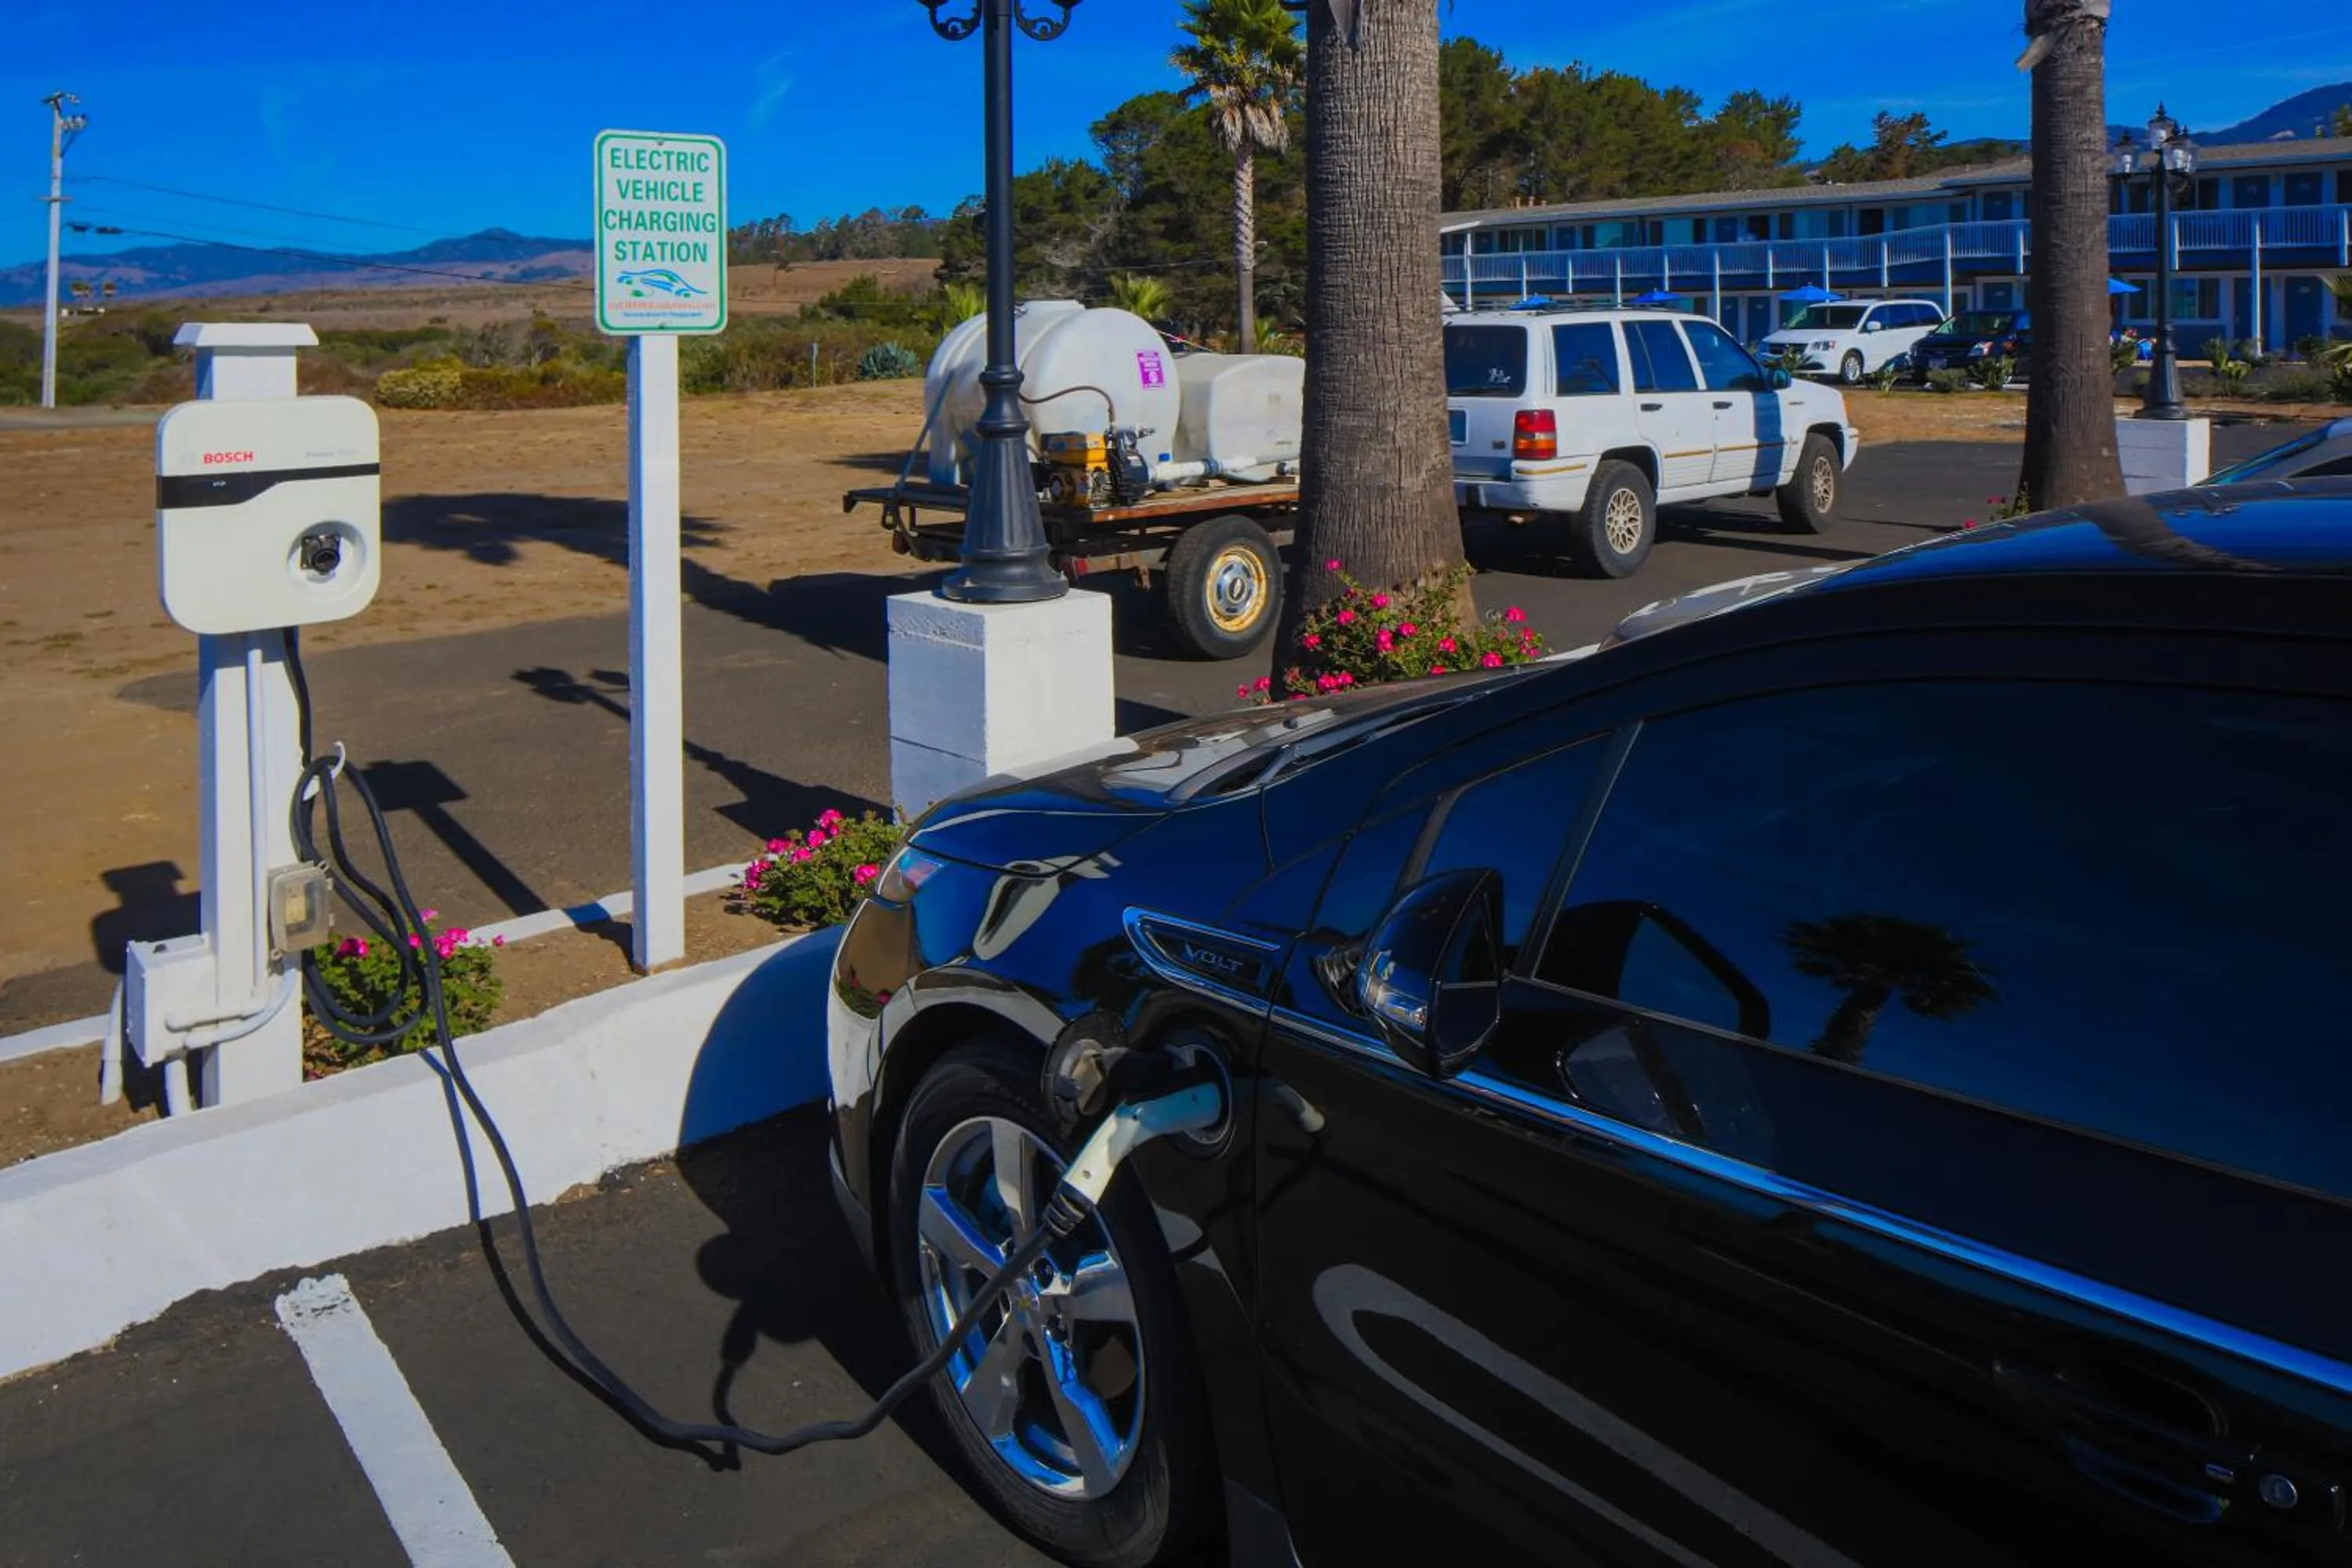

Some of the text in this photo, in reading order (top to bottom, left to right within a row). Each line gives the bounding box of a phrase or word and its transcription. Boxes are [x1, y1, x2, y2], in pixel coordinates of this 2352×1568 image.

[610, 148, 710, 172] ELECTRIC
[616, 179, 703, 201] VEHICLE
[603, 209, 716, 232] CHARGING
[615, 241, 709, 262] STATION
[203, 451, 254, 463] BOSCH
[1184, 942, 1243, 971] VOLT
